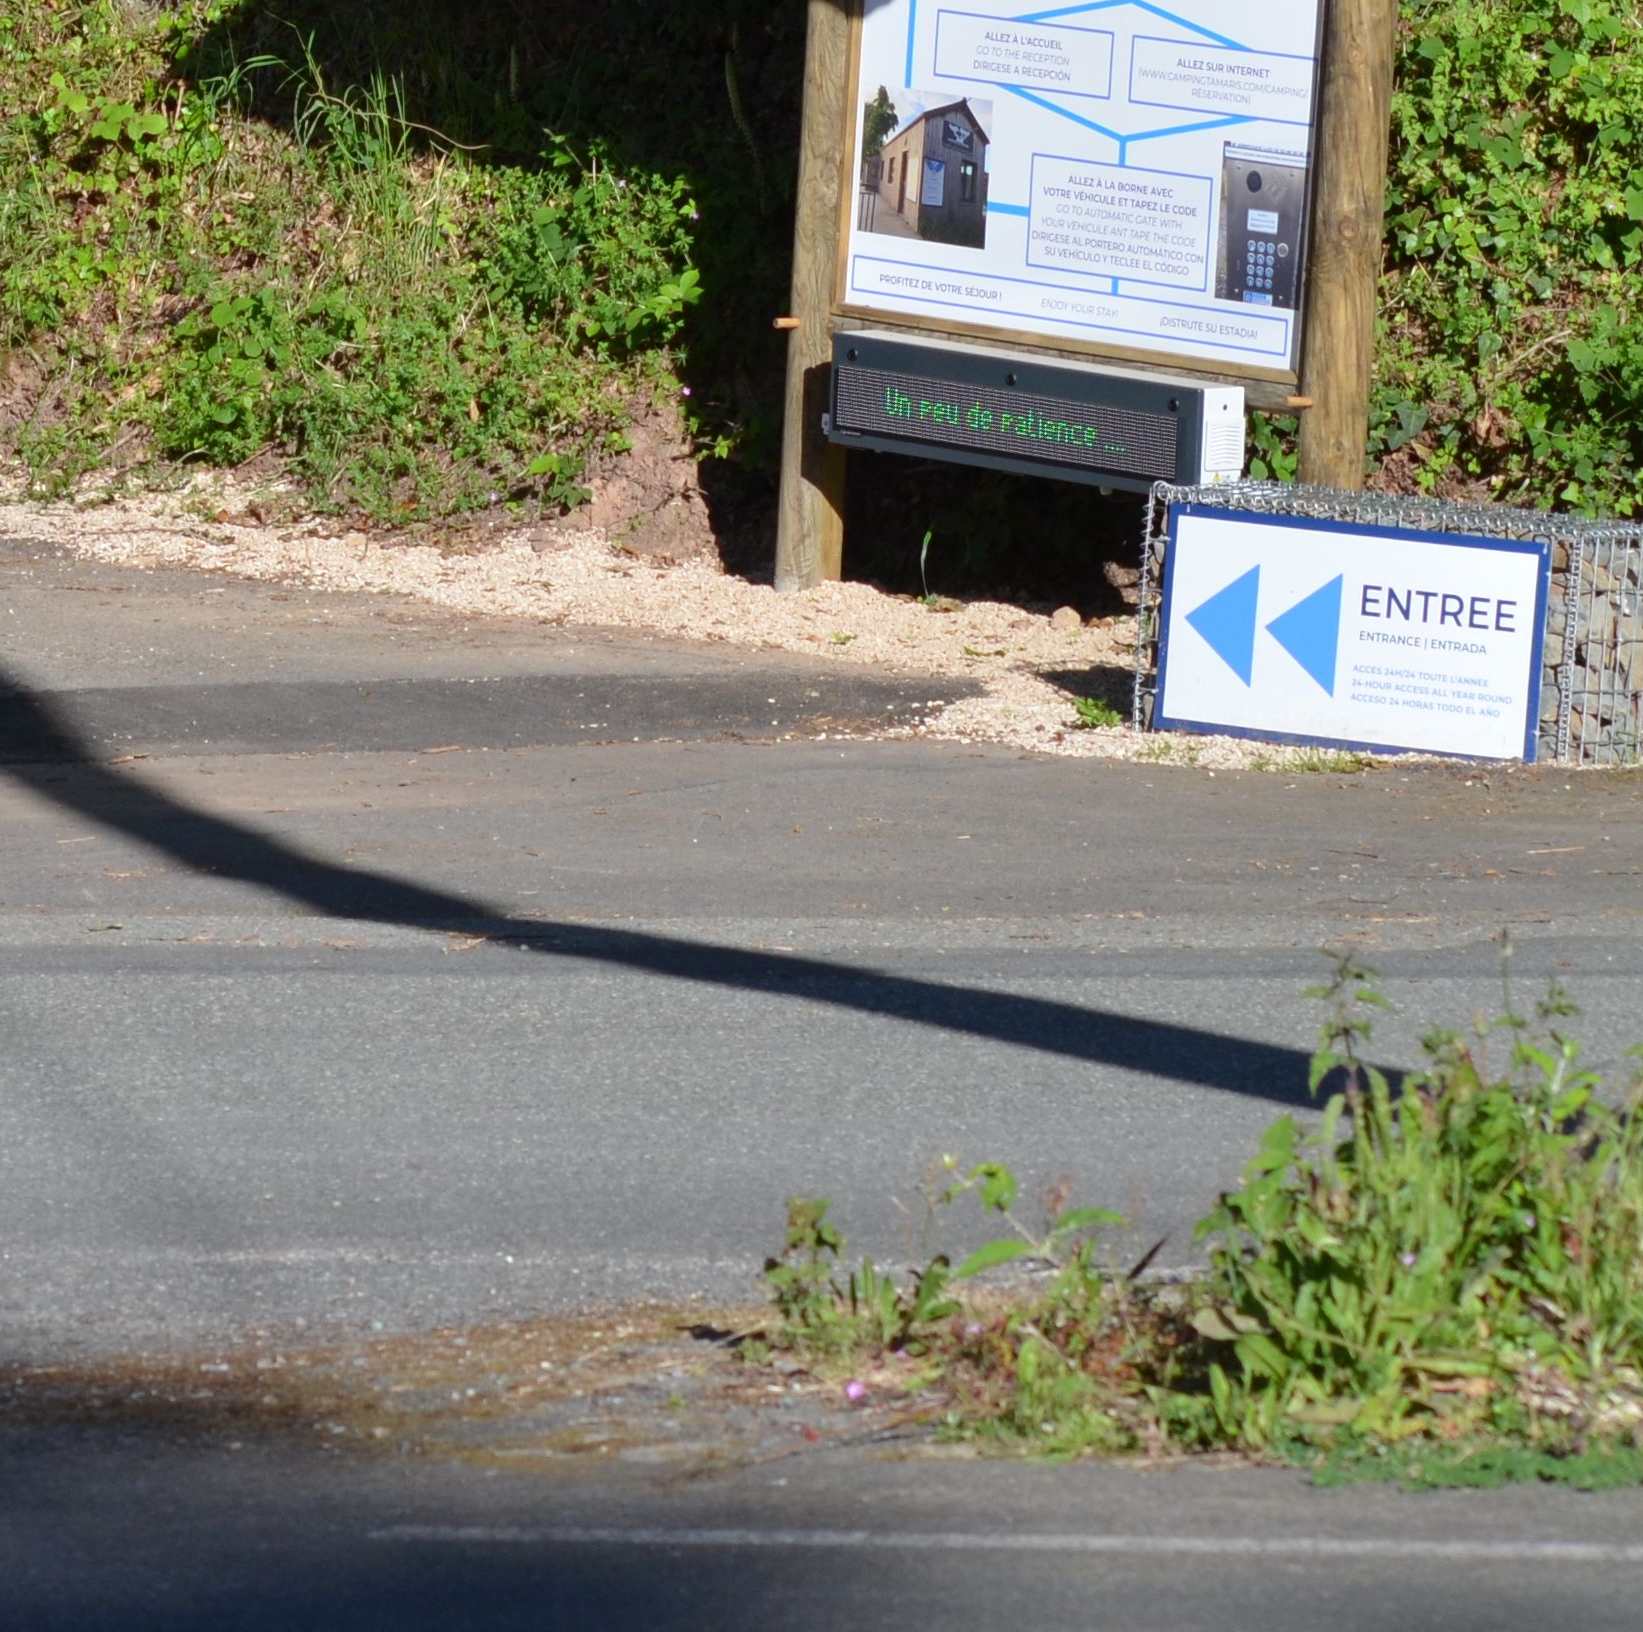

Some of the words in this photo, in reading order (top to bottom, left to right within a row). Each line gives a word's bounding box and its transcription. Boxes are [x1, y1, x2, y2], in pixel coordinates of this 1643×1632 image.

[985, 31, 1010, 43] ALLEZ
[1013, 32, 1018, 44] À
[1021, 36, 1062, 50] L'ACCUEIL
[973, 60, 1011, 73] DIRIGESE
[1014, 66, 1020, 74] A
[977, 46, 989, 55] GO
[992, 47, 1002, 57] TO
[1005, 49, 1020, 59] THE
[1023, 51, 1070, 66] RECEPTION
[1177, 58, 1204, 70] ALLEZ
[1206, 62, 1224, 72] SUR
[1227, 64, 1270, 78] INTERNET
[1068, 176, 1093, 187] ALLEZ
[1097, 178, 1102, 188] À
[1105, 181, 1115, 189] LA
[1118, 183, 1148, 194] BORNE
[1151, 188, 1174, 198] AVEC
[1043, 187, 1070, 198] VOTRE
[1074, 190, 1115, 205] VÉHICULE
[1118, 197, 1127, 206] ET
[1130, 199, 1157, 210] TAPEZ
[1160, 203, 1169, 212] LE
[1173, 205, 1197, 216] CODE
[880, 274, 919, 288] PROFITEZ
[921, 280, 932, 290] DE
[935, 283, 962, 295] VOTRE
[965, 286, 997, 299] SÉJOUR
[885, 387, 911, 418] Un
[919, 399, 958, 426] peu
[967, 401, 993, 431] de
[1001, 410, 1097, 447] patience
[1360, 585, 1517, 632] ENTREE
[1359, 631, 1421, 647] ENTRANCE
[1431, 638, 1487, 654] ENTRADA
[1353, 665, 1382, 675] ACCES
[1384, 669, 1415, 679] 24H/24
[1419, 672, 1448, 682] TOUTE
[1394, 684, 1429, 695] ACCESS
[1432, 688, 1447, 697] ALL
[1452, 691, 1475, 700] YEAR
[1478, 694, 1512, 704] ROUND
[1350, 694, 1386, 704] ACCESO
[1403, 699, 1434, 710] HORAS
[1437, 703, 1463, 713] TODO
[1480, 707, 1499, 717] AÑO
